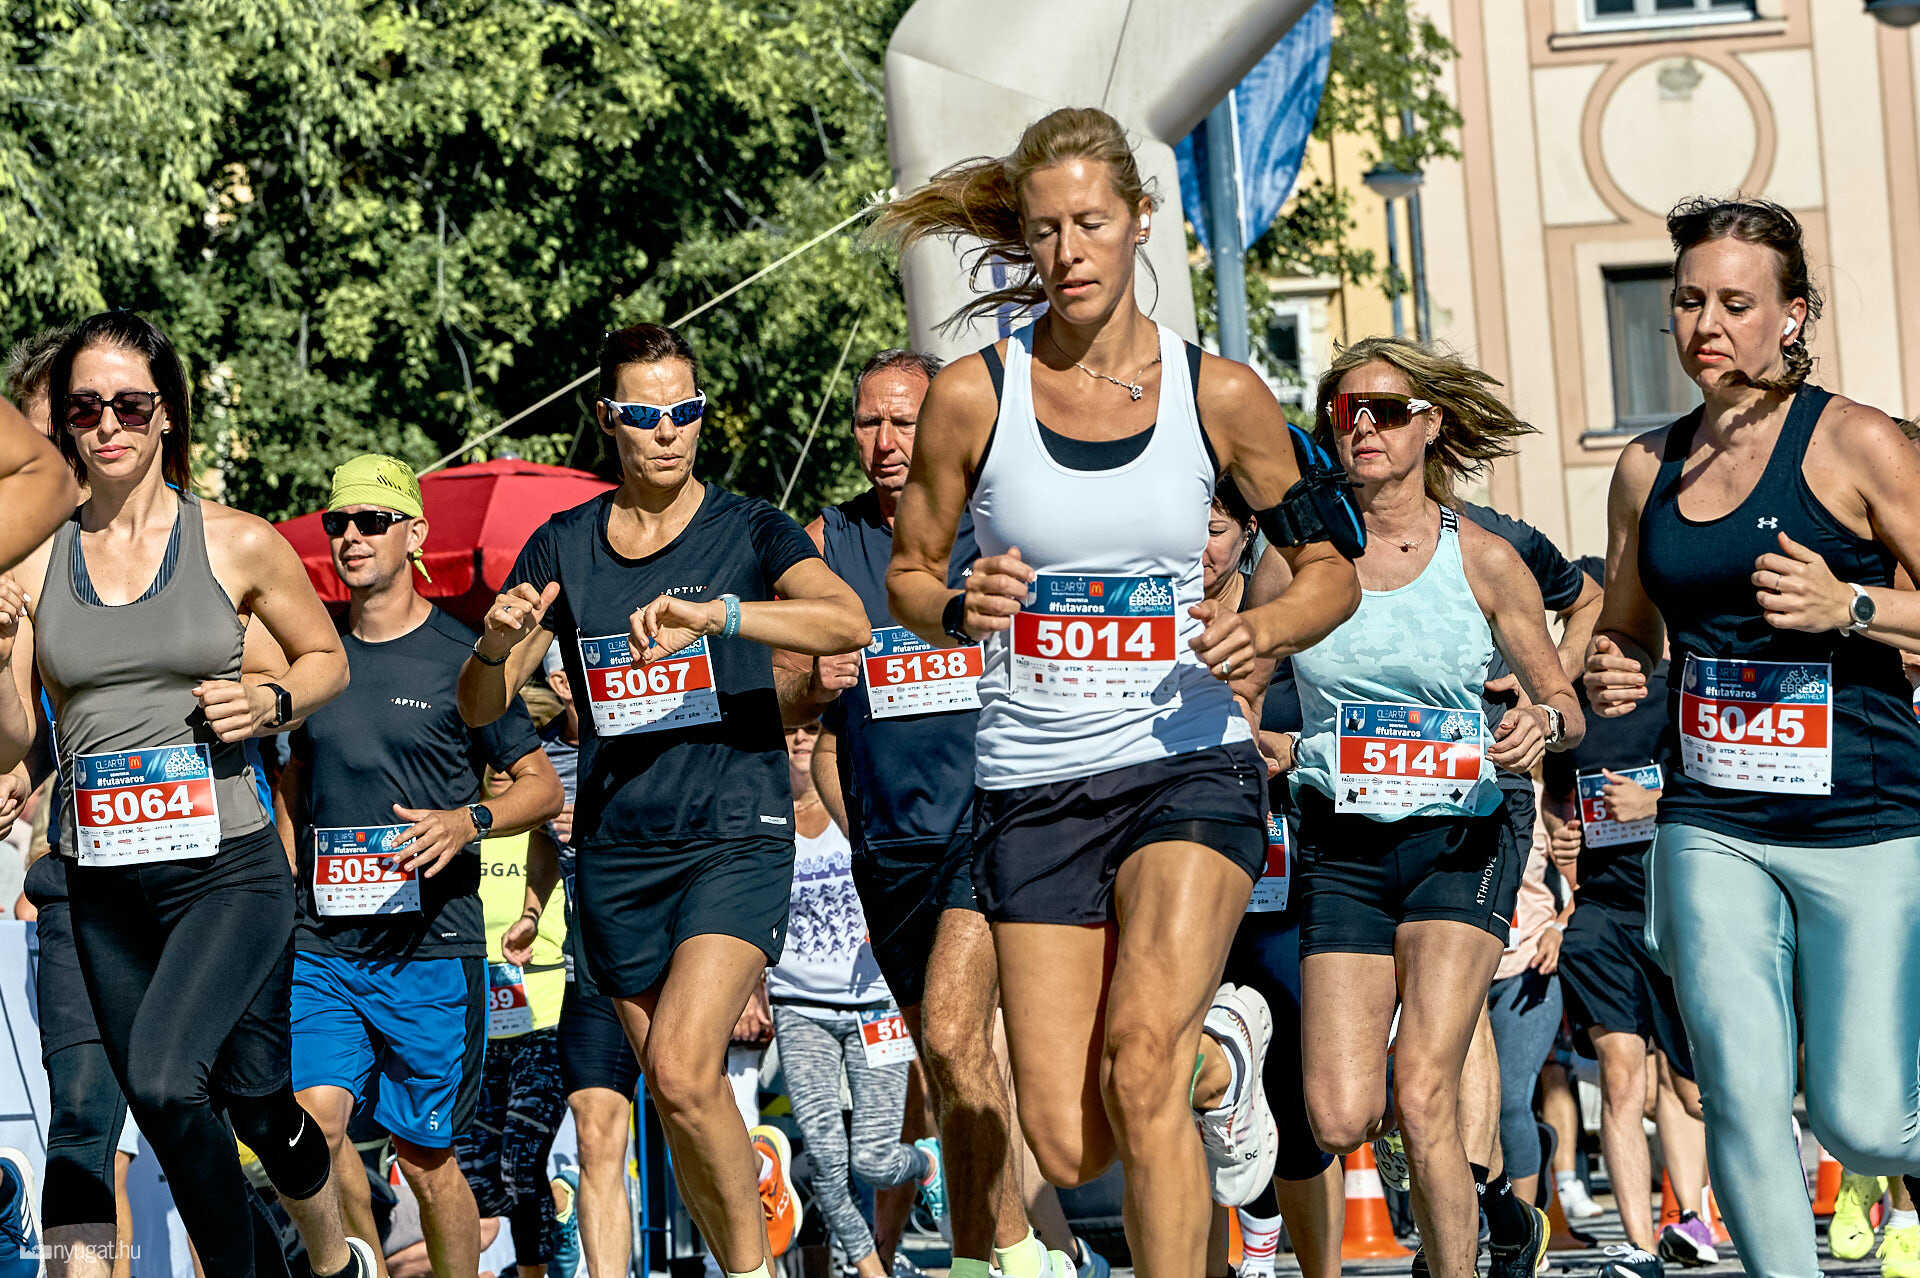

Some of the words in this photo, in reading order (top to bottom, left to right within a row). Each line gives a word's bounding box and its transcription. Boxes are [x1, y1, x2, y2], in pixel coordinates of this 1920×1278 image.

[664, 585, 703, 596] APTIV
[1049, 601, 1105, 613] #futavaros
[893, 643, 931, 653] #futavaros
[1036, 620, 1156, 659] 5014
[610, 656, 634, 665] #futav
[886, 651, 968, 683] 5138
[604, 661, 691, 699] 5067
[1705, 685, 1757, 699] #futavaros
[394, 697, 428, 710] APTIV
[1375, 726, 1422, 738] #futavaros
[1697, 703, 1805, 745] 5045
[1362, 741, 1457, 777] 5141
[97, 775, 145, 787] #futavaros
[91, 784, 194, 826] 5064
[328, 857, 402, 883] 5052
[1476, 856, 1498, 906] ATHMOVE
